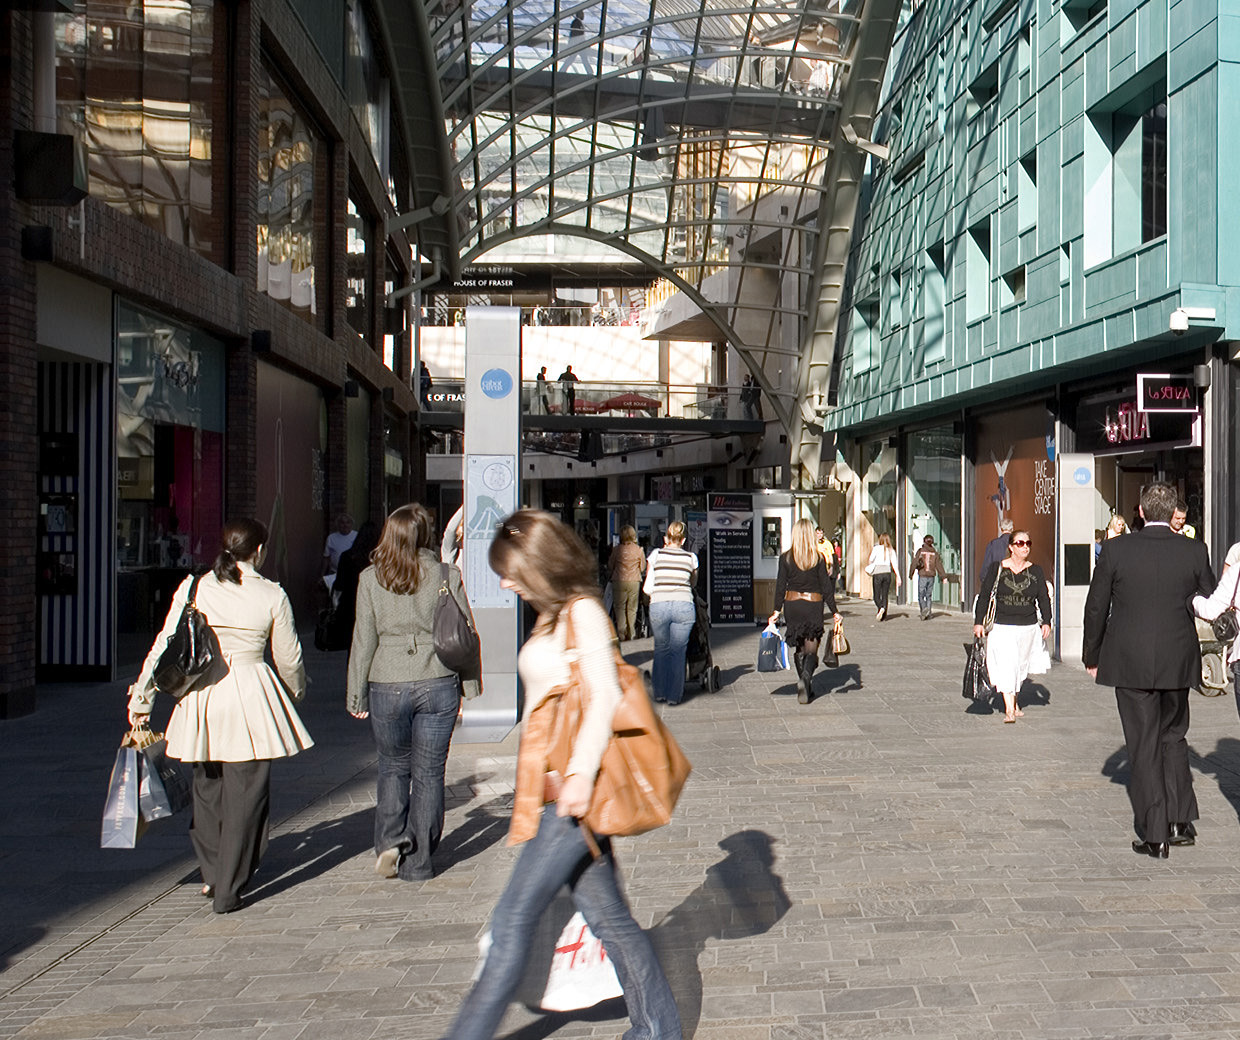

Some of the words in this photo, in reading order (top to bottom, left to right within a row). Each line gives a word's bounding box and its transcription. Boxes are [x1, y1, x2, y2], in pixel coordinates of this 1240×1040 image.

[433, 394, 445, 402] OF
[1148, 386, 1160, 399] La
[1161, 386, 1191, 399] SENZA
[1034, 460, 1048, 478] TAKE
[1034, 478, 1055, 496] CENTRE
[1034, 496, 1051, 515] STAGE
[920, 551, 936, 572] T
